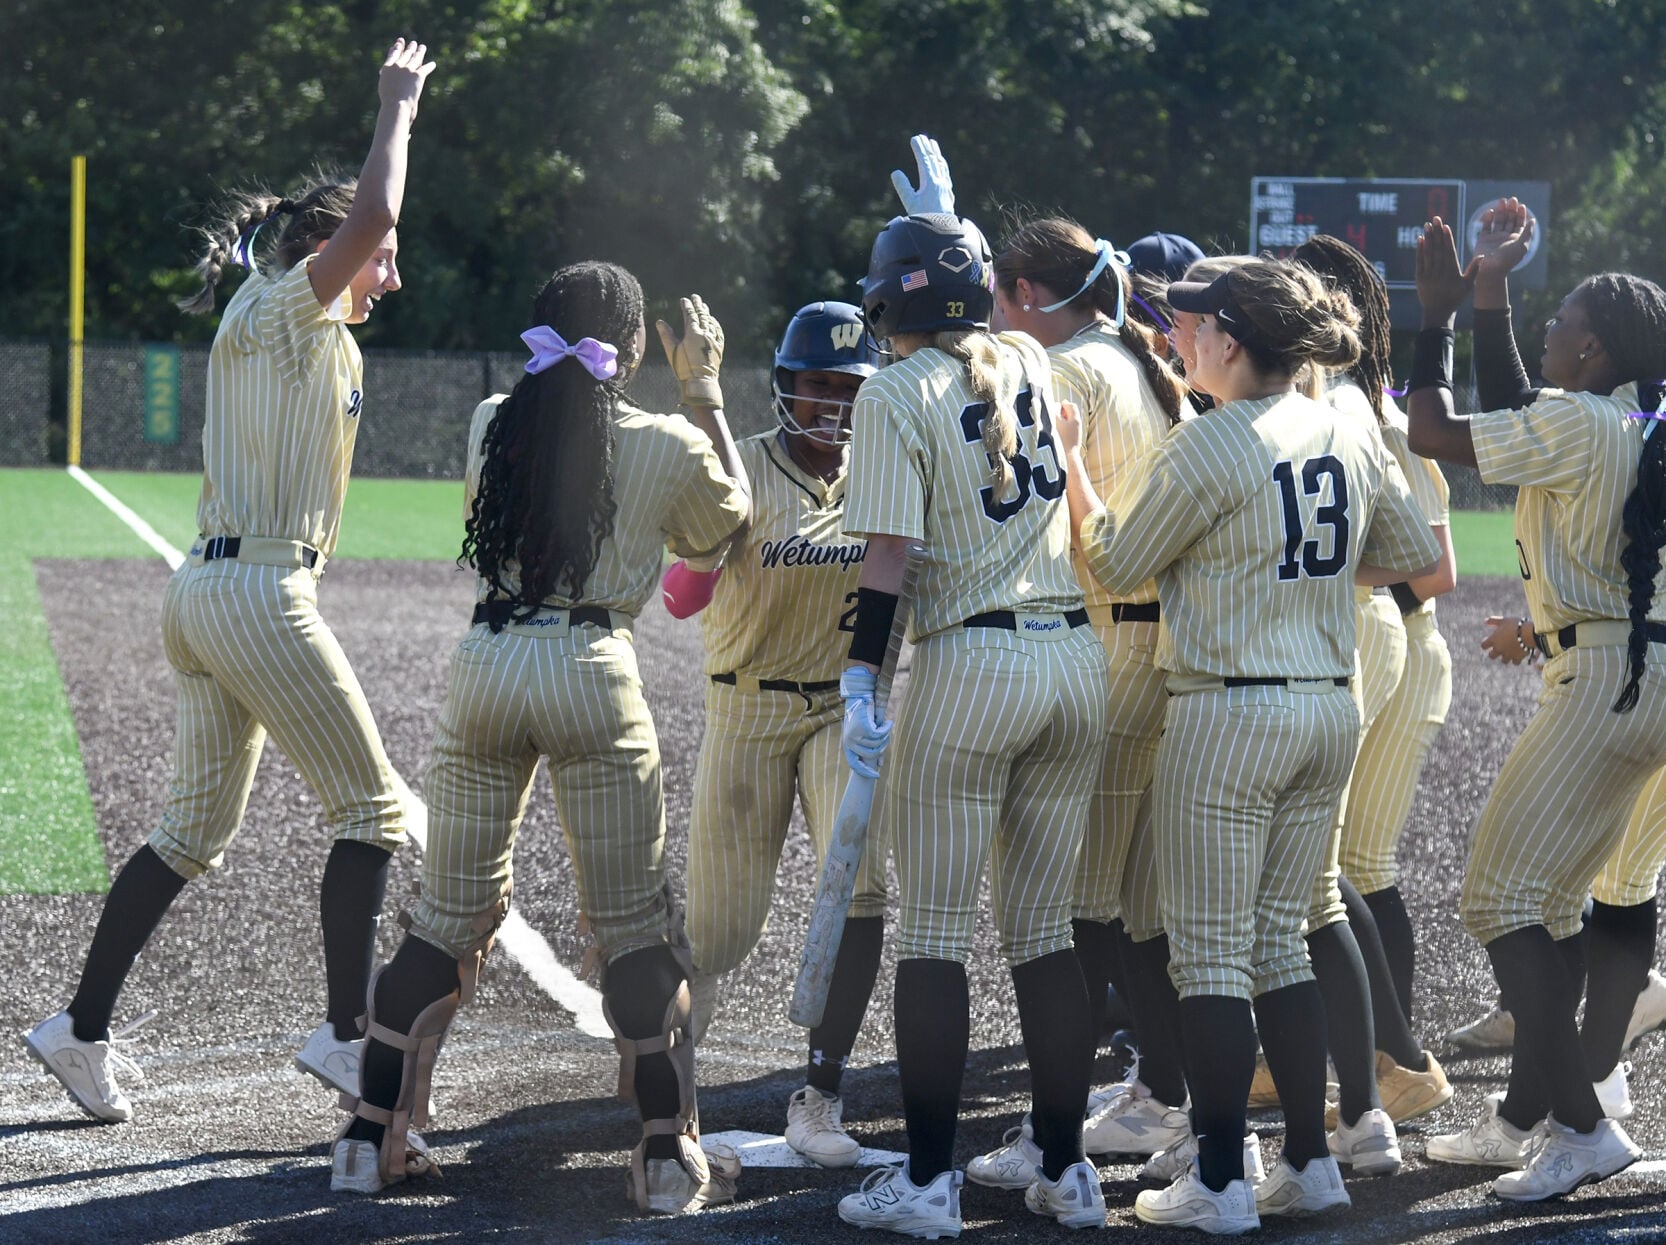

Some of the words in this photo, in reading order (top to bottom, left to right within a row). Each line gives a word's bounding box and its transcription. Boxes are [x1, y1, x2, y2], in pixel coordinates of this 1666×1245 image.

[1356, 192, 1398, 214] TIME
[1259, 224, 1318, 247] GUEST
[1397, 226, 1425, 248] HO
[946, 301, 964, 318] 33
[830, 323, 865, 351] W
[959, 389, 1067, 525] 33
[1272, 453, 1350, 581] 13
[760, 534, 869, 573] Wetump
[1023, 619, 1062, 632] Wetumpka
